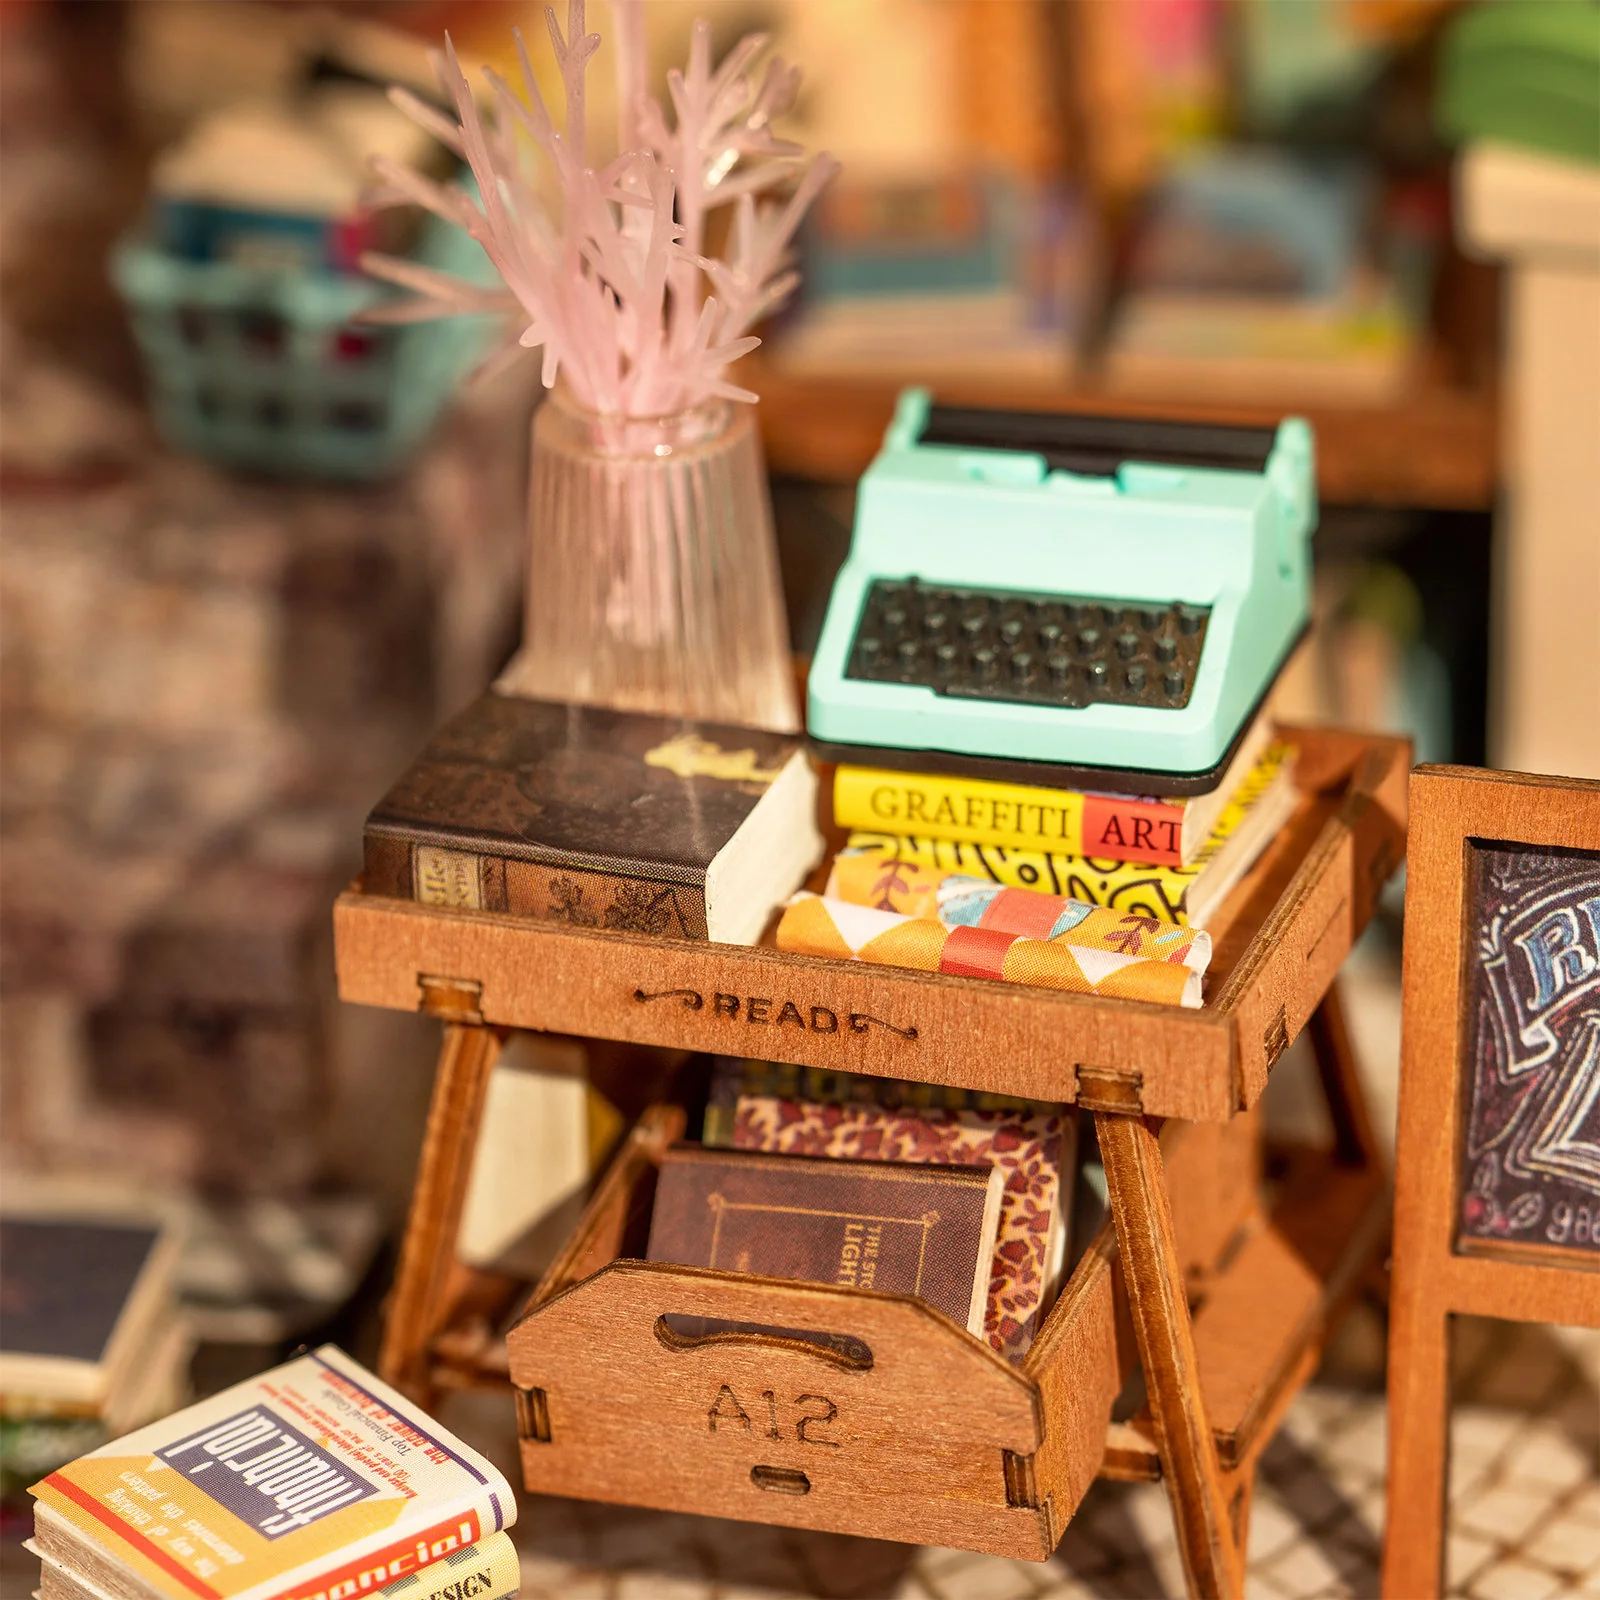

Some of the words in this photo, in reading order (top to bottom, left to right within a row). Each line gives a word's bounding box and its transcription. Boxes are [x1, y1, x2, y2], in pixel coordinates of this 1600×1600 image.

[870, 786, 1072, 839] GRAFFITI
[1100, 815, 1182, 854] ART
[713, 992, 838, 1034] READ
[863, 1224, 881, 1258] THE
[346, 1410, 395, 1442] Financial
[371, 1406, 392, 1420] of
[707, 1384, 840, 1448] A12
[388, 1418, 429, 1447] power
[392, 1439, 412, 1456] Top
[374, 1453, 399, 1469] years
[424, 1446, 453, 1465] the
[118, 1472, 168, 1502] pattern
[165, 1411, 364, 1535] financial
[105, 1487, 152, 1525] thinking
[161, 1503, 185, 1519] the
[145, 1524, 170, 1537] of
